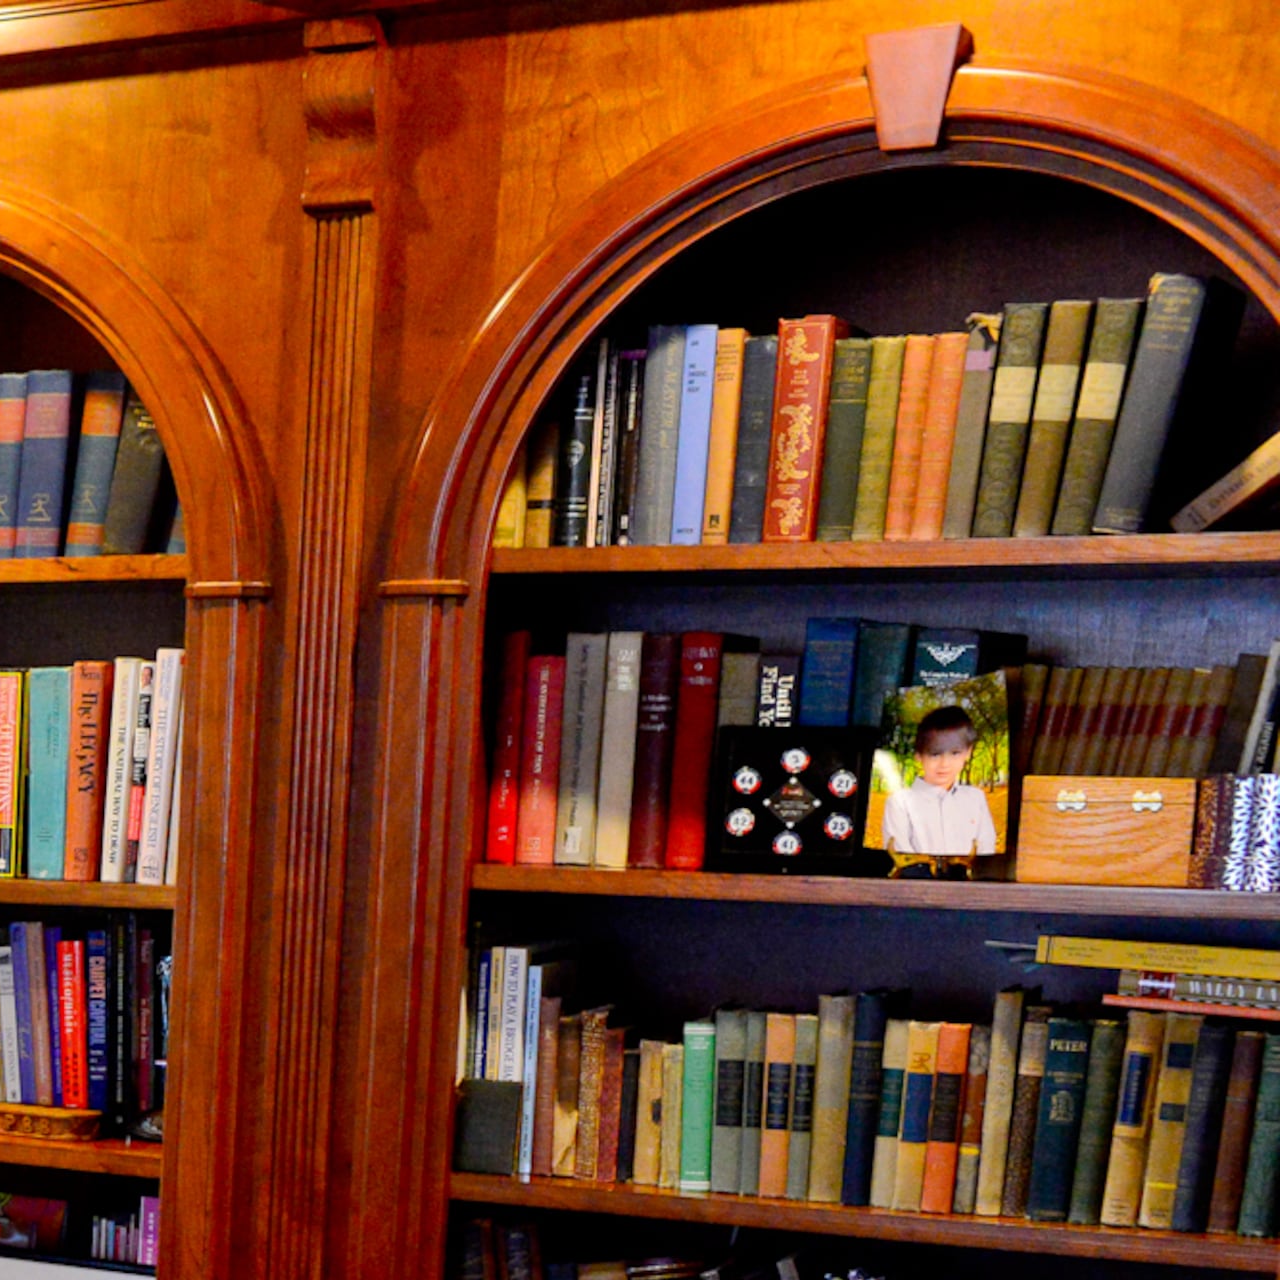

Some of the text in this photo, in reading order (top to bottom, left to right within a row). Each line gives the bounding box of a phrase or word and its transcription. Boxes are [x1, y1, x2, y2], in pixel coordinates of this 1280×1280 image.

[758, 666, 779, 727] Find Yo
[775, 674, 795, 718] Until
[117, 726, 126, 745] THE
[114, 748, 125, 793] NATURAL
[146, 708, 167, 848] THE STORY OF ENGLISH
[740, 776, 754, 784] 44
[836, 779, 850, 788] 21
[112, 797, 121, 816] WAY
[111, 819, 119, 832] TO
[831, 822, 846, 831] 35
[108, 834, 118, 864] DRAW
[781, 840, 794, 849] 41
[509, 955, 520, 976] HOW
[508, 980, 519, 992] TO
[1189, 980, 1245, 998] WALLY
[89, 956, 106, 1045] CARPET CAPITAL
[506, 995, 518, 1016] PLAY
[504, 1027, 516, 1065] BRIDGE
[1049, 1038, 1088, 1053] PETER
